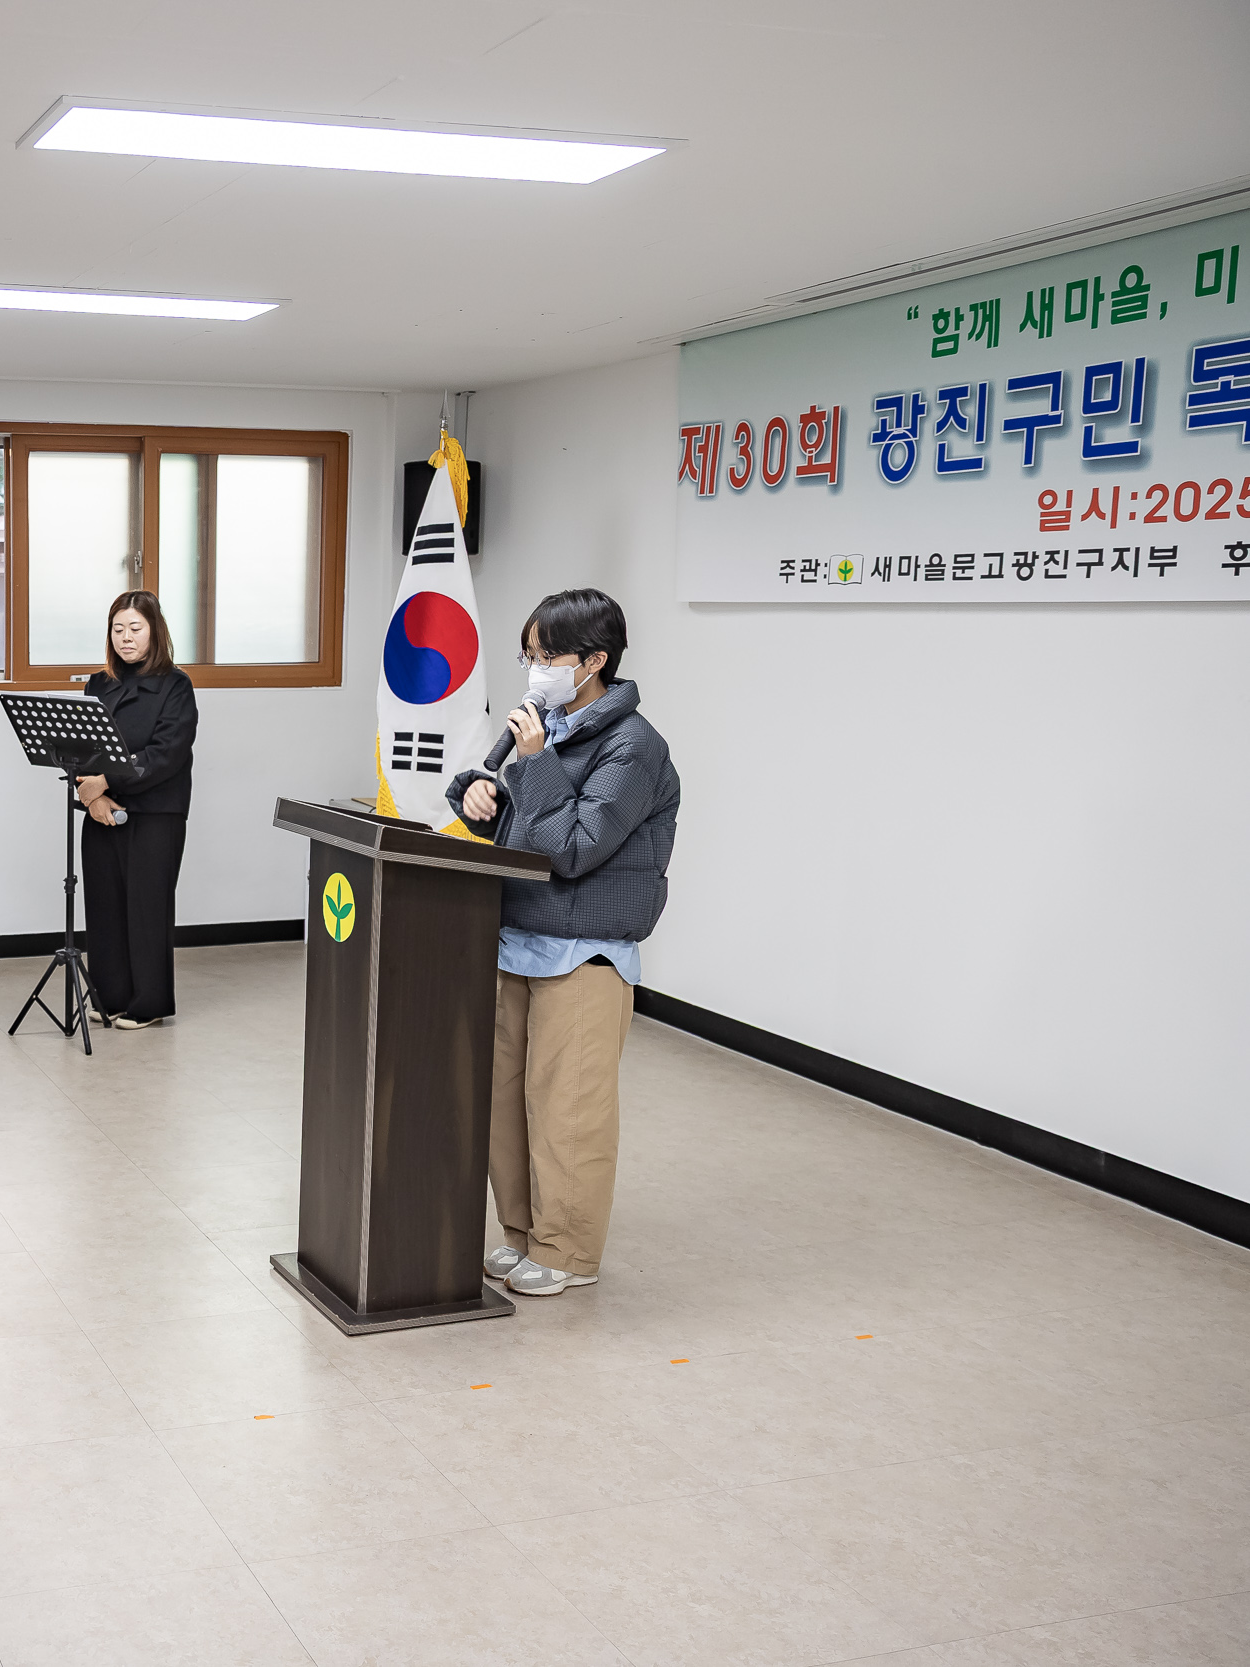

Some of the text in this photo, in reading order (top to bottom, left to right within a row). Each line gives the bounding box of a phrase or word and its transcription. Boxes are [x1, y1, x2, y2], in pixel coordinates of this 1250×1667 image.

[1018, 264, 1169, 340] 새마을,
[1195, 244, 1240, 305] 미
[678, 403, 842, 497] 제30회
[870, 355, 1148, 484] 광진구민
[778, 557, 829, 585] 주관:
[869, 544, 1179, 583] 새마을문고광진구지부
